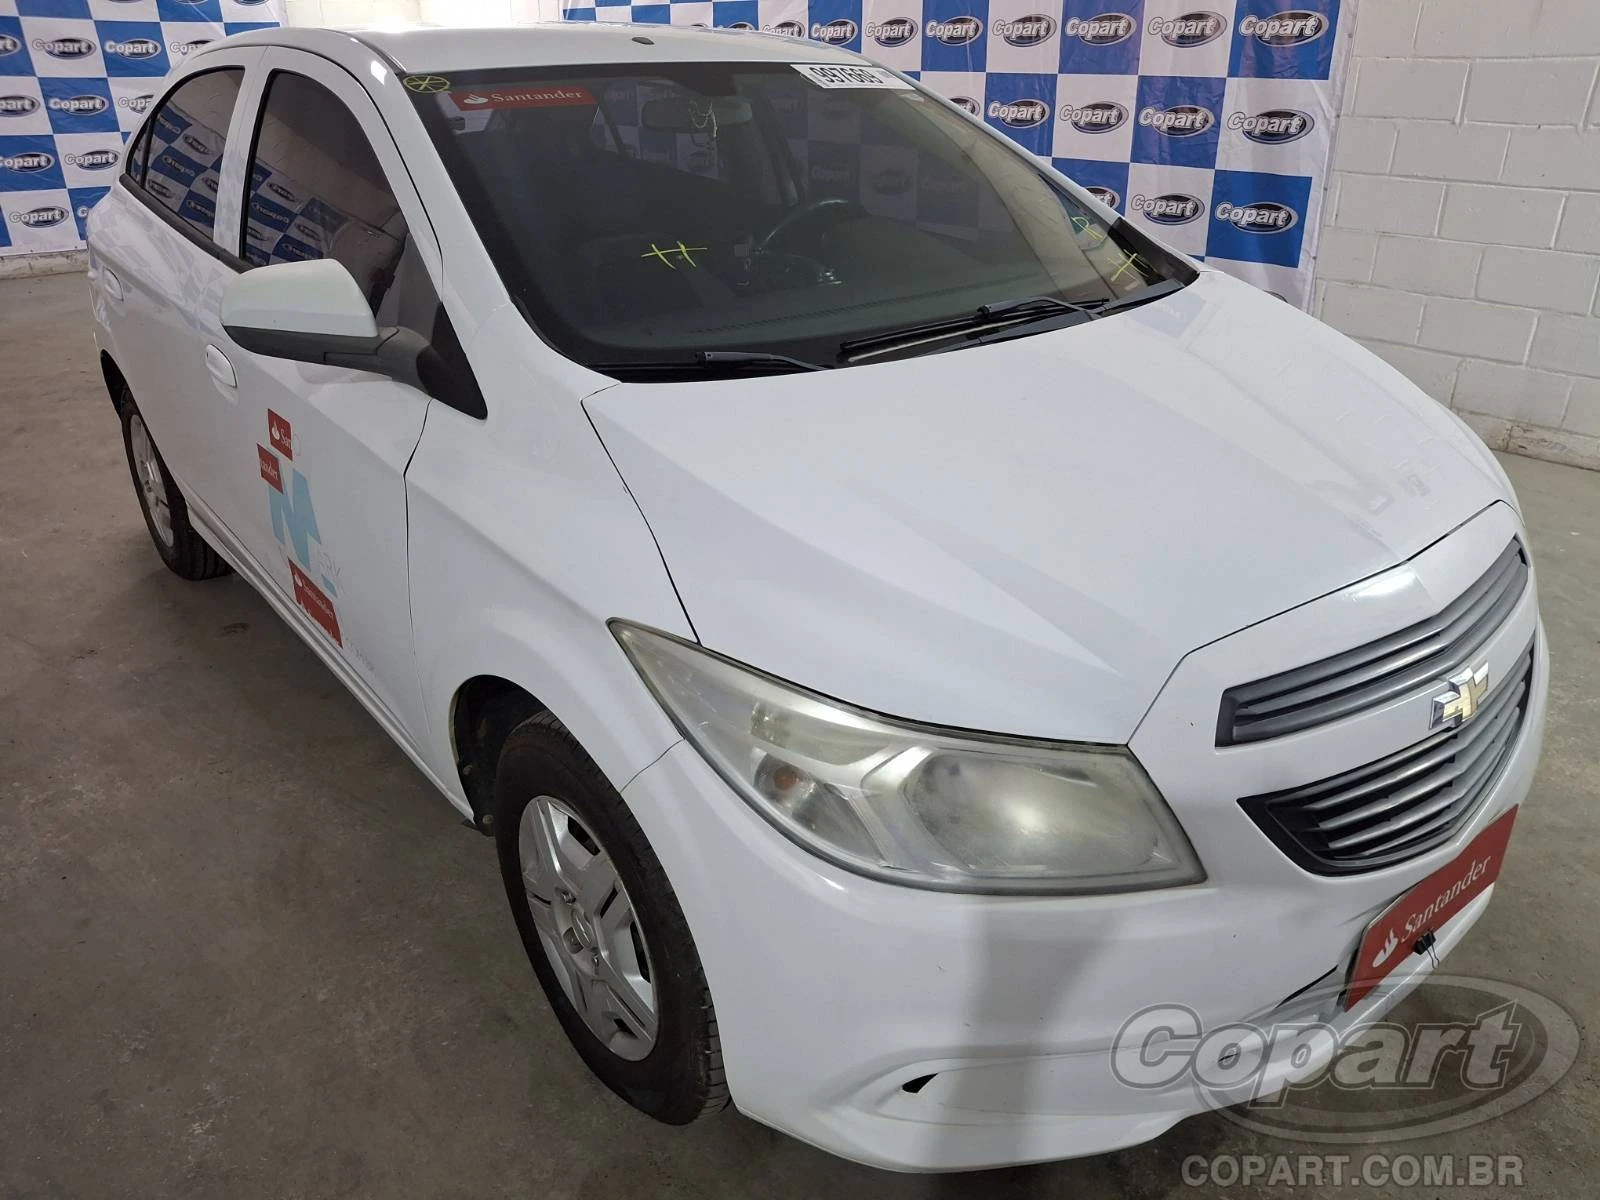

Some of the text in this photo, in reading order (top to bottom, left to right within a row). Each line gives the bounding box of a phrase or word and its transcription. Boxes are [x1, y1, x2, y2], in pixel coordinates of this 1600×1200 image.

[811, 23, 853, 41] Copart
[865, 21, 915, 40] Copart
[925, 20, 977, 39] Copart
[992, 18, 1048, 38] Copart
[1064, 16, 1129, 38] Copart
[1148, 16, 1216, 37] Copart
[1239, 10, 1318, 37] Copart
[32, 39, 89, 56] Copart
[104, 41, 155, 55] Copart
[809, 66, 884, 84] 997669
[0, 97, 32, 111] part
[50, 98, 103, 113] Copart
[118, 96, 153, 110] Copa
[491, 89, 583, 104] Santander
[987, 101, 1044, 122] Copart
[1059, 104, 1120, 126] Copart
[1138, 105, 1204, 129] Copart
[1226, 111, 1302, 136] Copart
[0, 155, 49, 169] opart
[64, 153, 115, 166] Copart
[9, 207, 62, 224] Copart
[1131, 194, 1195, 218] Copart
[1215, 201, 1288, 228] Copart
[1400, 855, 1491, 944] Santander
